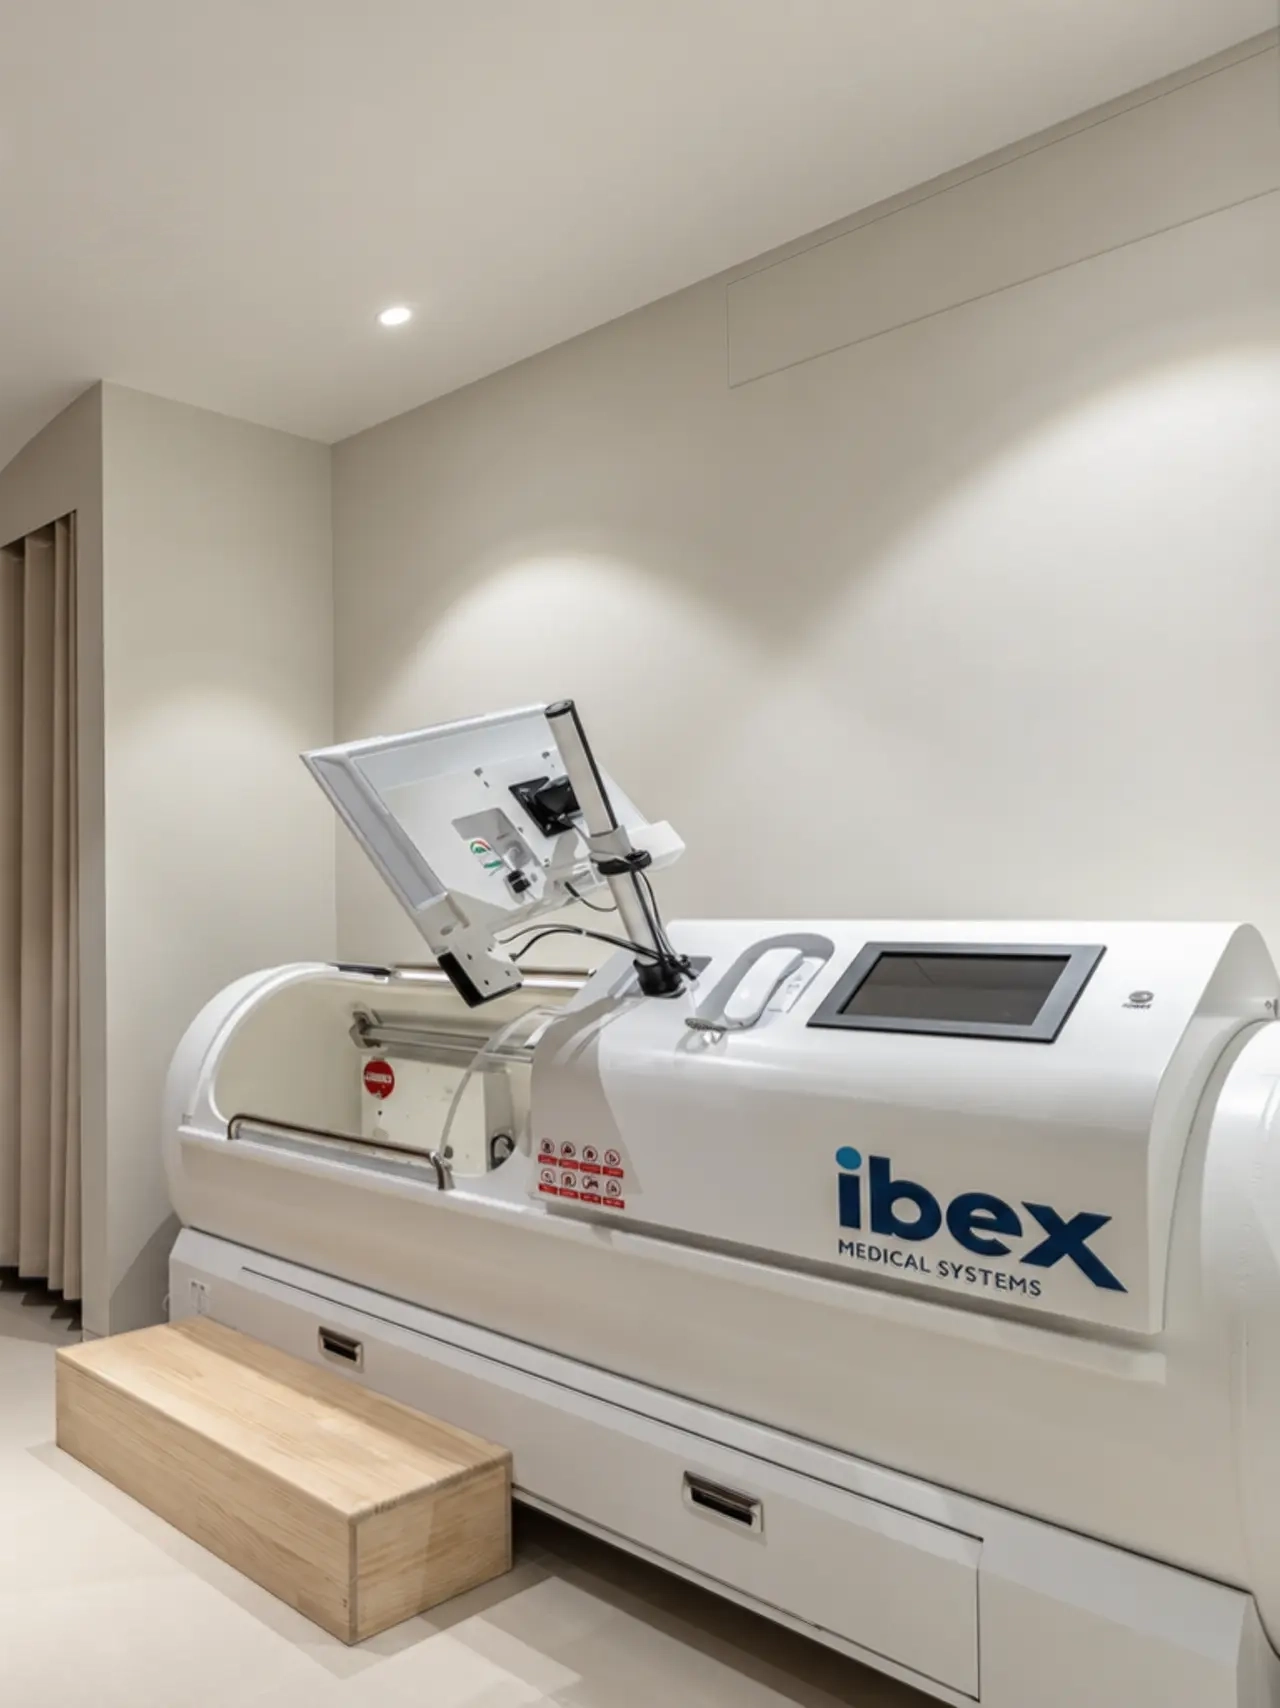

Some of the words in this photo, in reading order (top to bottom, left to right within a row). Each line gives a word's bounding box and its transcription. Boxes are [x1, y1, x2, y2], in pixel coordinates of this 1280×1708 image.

[835, 1146, 1128, 1293] ibex
[838, 1239, 931, 1273] MEDICAL
[937, 1260, 1042, 1296] SYSTEMS
